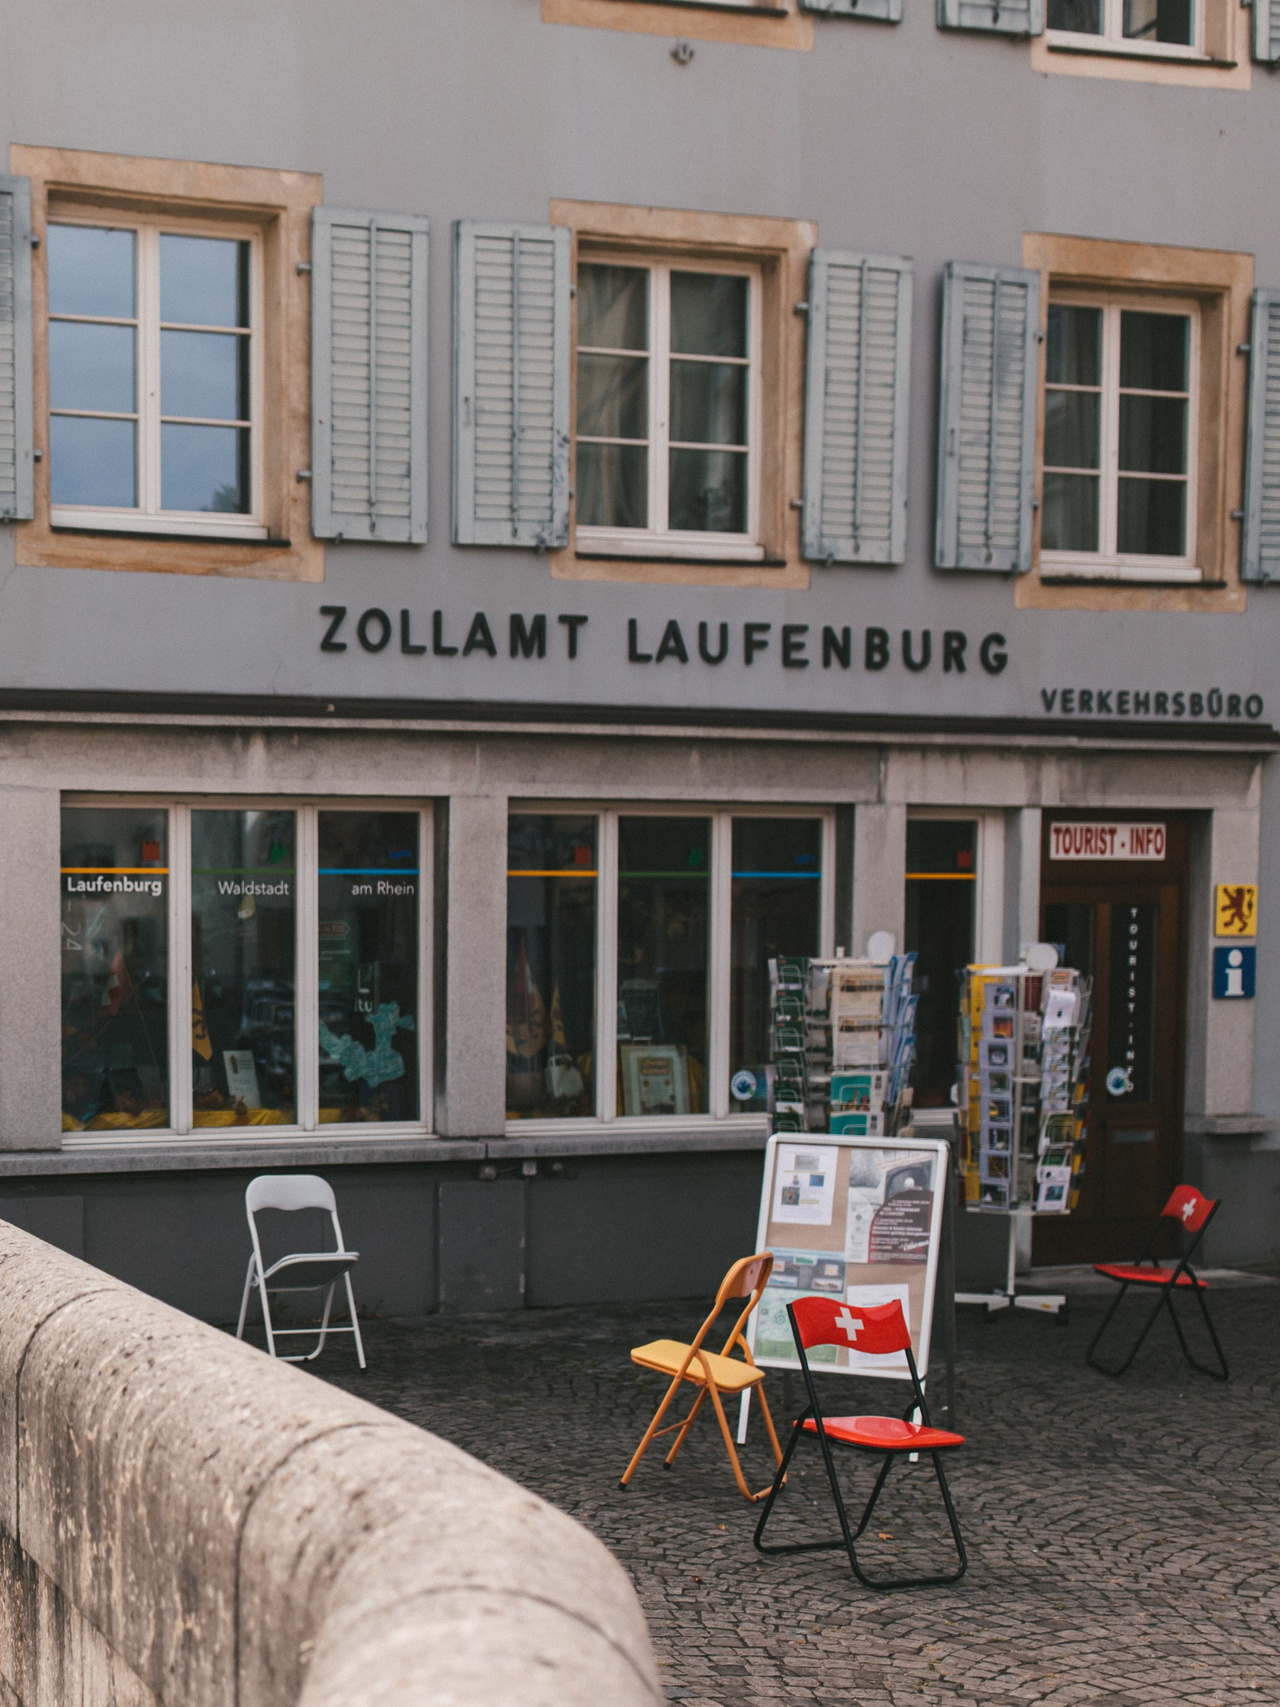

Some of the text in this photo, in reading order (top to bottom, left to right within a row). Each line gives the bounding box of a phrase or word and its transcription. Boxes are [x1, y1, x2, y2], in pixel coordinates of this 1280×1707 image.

[320, 605, 1009, 675] ZOLLAMT LAUFENBURG
[1041, 686, 1265, 719] VERKEHRSBÜRO
[1053, 826, 1118, 855] TOURIST
[1129, 826, 1165, 855] INFO
[67, 876, 163, 897] Laufenburg
[218, 880, 290, 896] Waldstadt
[351, 880, 415, 896] am Rhein
